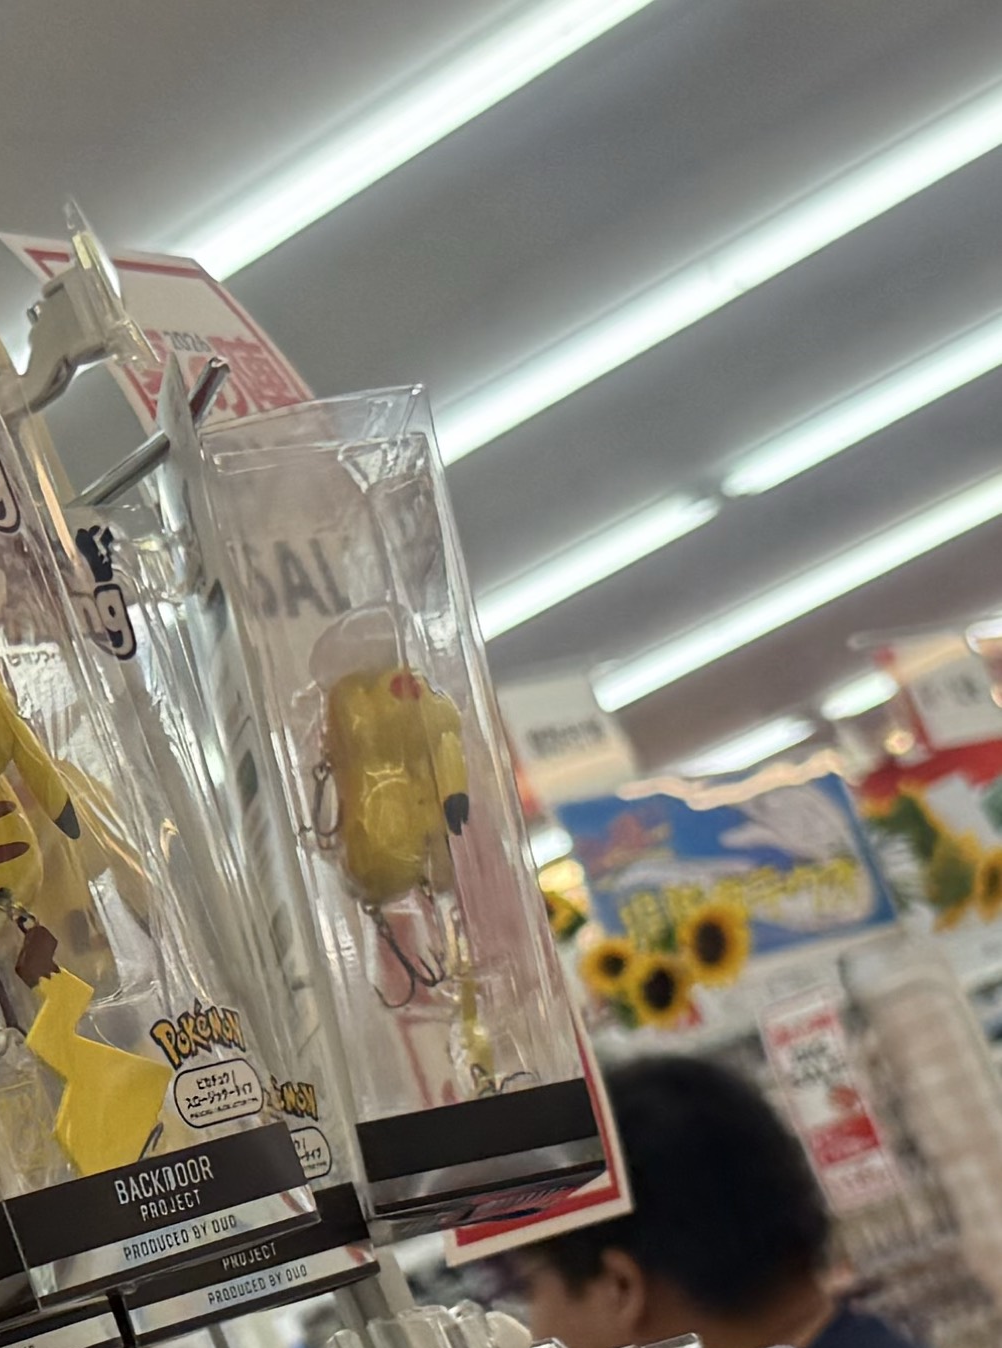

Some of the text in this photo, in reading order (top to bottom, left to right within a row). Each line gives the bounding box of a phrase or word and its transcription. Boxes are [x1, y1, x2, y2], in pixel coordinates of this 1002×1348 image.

[114, 1155, 215, 1205] BACKDOOR
[139, 1189, 202, 1222] PROJECT
[123, 1213, 238, 1261] PRODUCED BY DUO
[207, 1263, 309, 1306] PRODUCED BY DUO
